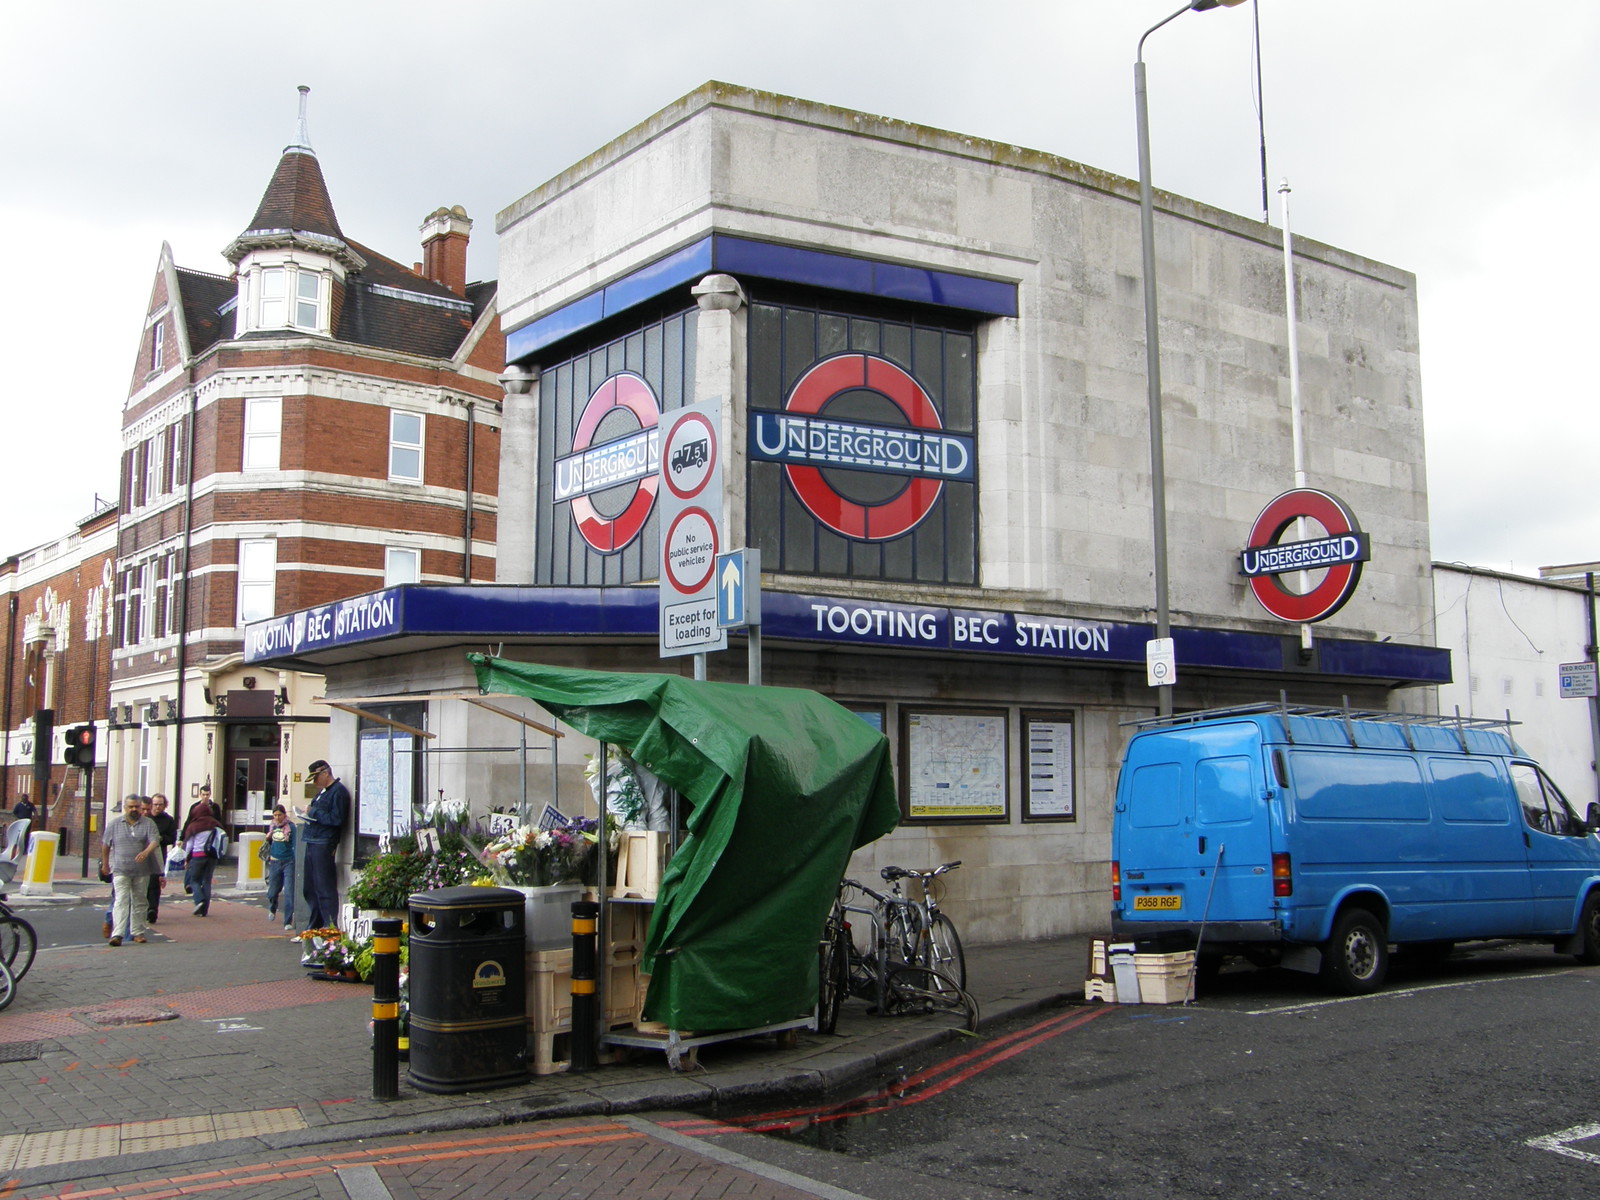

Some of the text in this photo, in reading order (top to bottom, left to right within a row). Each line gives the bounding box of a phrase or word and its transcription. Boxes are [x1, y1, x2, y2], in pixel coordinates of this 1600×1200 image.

[683, 440, 707, 462] 7.5T
[756, 415, 968, 475] UNDERGROUND
[558, 440, 659, 497] UNDERGROUN
[685, 534, 696, 544] No
[669, 542, 713, 560] public service
[1243, 536, 1359, 574] UNDERGROUND
[678, 555, 706, 568] vehicles
[251, 597, 394, 654] TOOTING BEC STATION
[669, 608, 716, 626] Except for
[675, 625, 711, 641] loading
[811, 604, 1109, 652] TOOTING BEC STATION
[1137, 896, 1178, 908] P358 RGF
